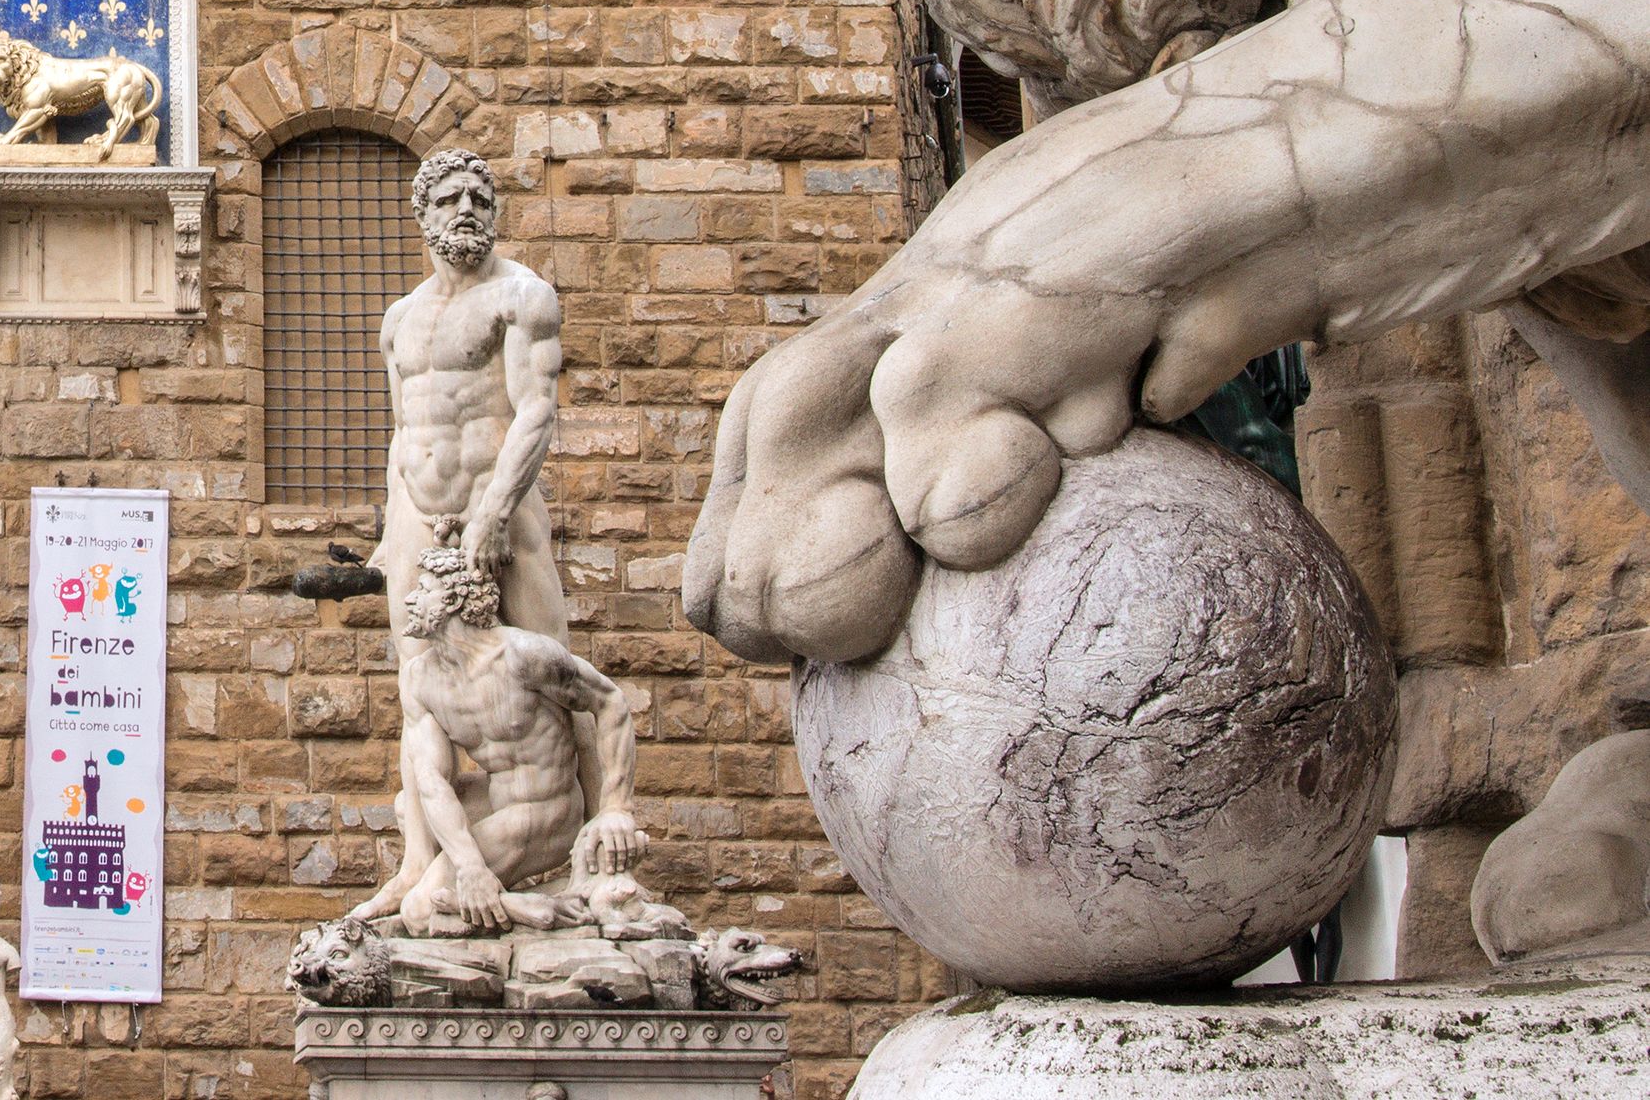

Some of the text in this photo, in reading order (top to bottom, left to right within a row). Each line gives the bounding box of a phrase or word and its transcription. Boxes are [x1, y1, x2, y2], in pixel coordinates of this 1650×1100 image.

[45, 535, 154, 551] 19-20-21 Maggio 2017
[52, 629, 135, 656] Firenze
[57, 663, 79, 679] dei
[50, 683, 142, 709] bambini
[49, 718, 140, 733] Città come casa
